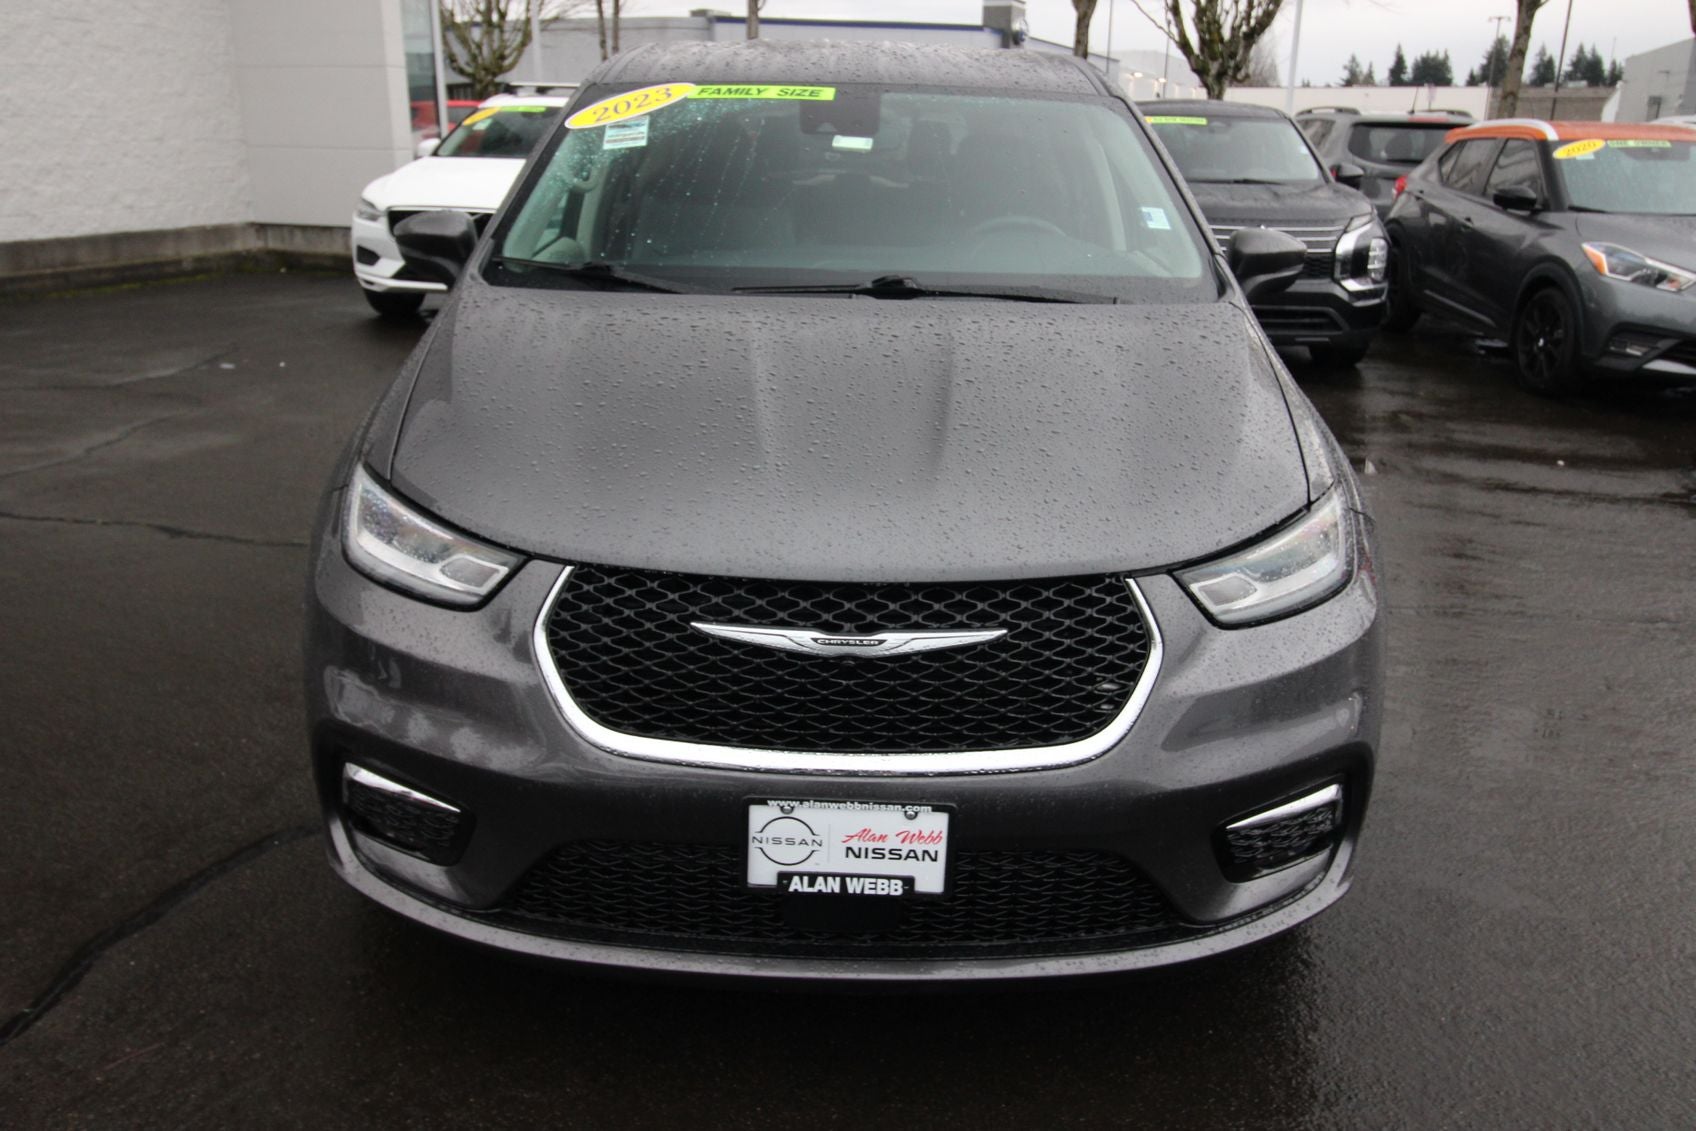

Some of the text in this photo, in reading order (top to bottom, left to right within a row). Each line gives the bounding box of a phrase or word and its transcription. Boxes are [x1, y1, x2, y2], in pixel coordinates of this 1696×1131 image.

[697, 87, 824, 98] FAMILY SIZE
[592, 87, 673, 123] 2023
[767, 800, 932, 813] www.alanwebbnissan.com
[751, 836, 823, 847] NISSAN
[842, 827, 943, 845] Alan Webb
[845, 846, 938, 862] NISSAN
